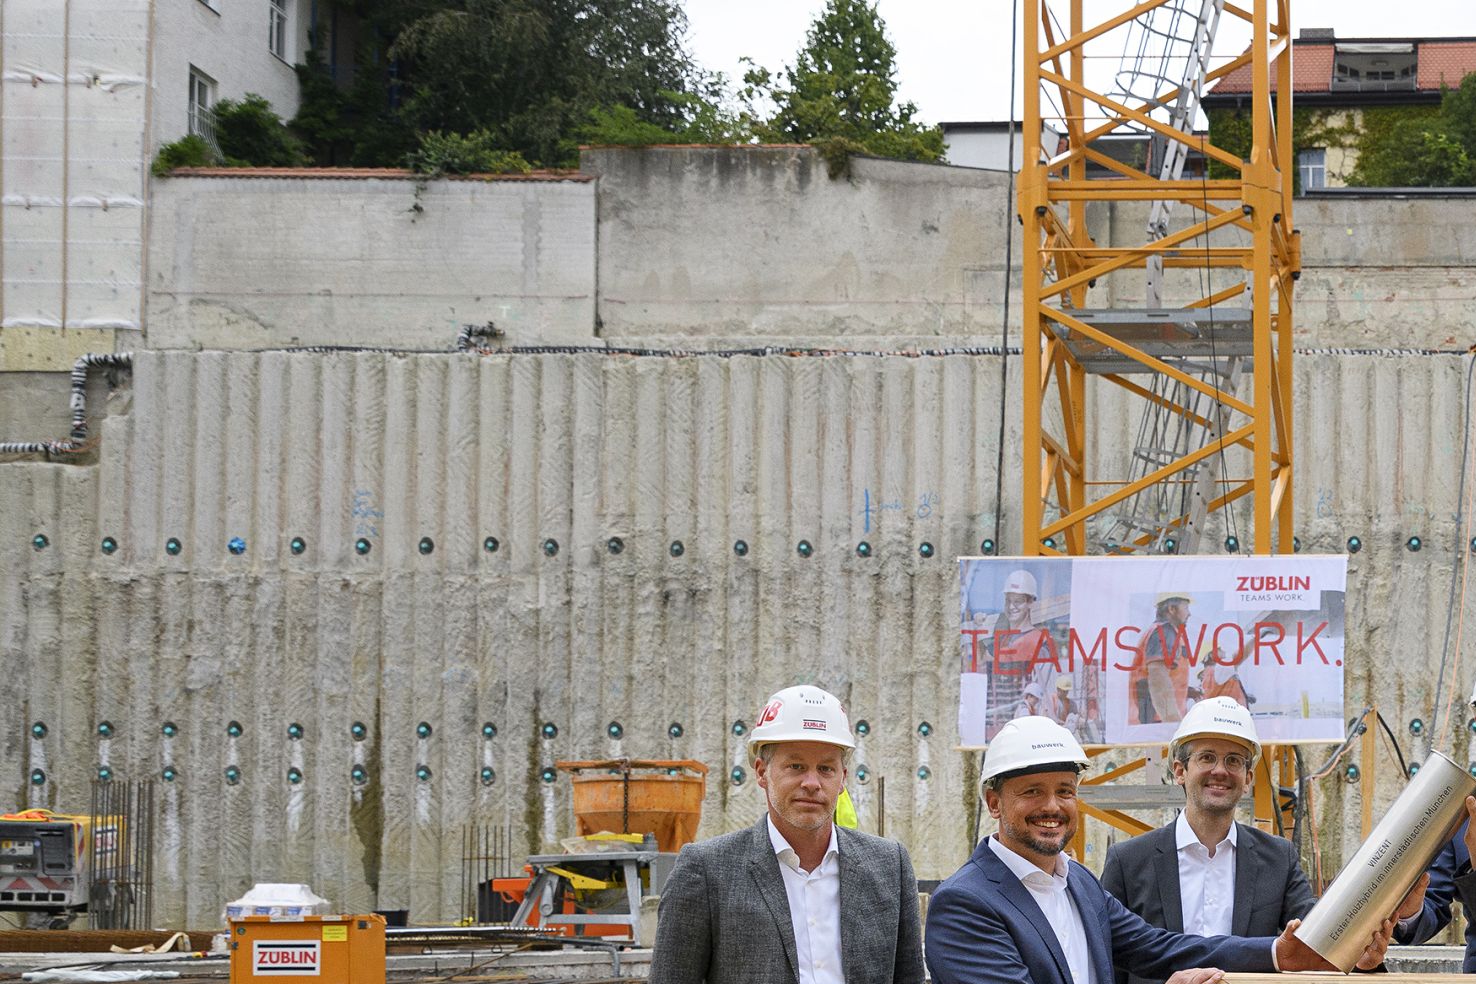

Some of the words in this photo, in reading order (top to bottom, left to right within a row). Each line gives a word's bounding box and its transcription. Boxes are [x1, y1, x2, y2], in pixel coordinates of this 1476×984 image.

[1236, 576, 1311, 592] ZÜBLIN
[1240, 594, 1272, 602] TEAMS
[1367, 838, 1392, 868] VINZENT
[1329, 918, 1350, 942] Erster
[1346, 881, 1378, 920] Holzhybrid
[1383, 816, 1430, 875] innerstädtischen
[1425, 784, 1453, 818] München
[257, 951, 317, 964] ZÜBLIN
